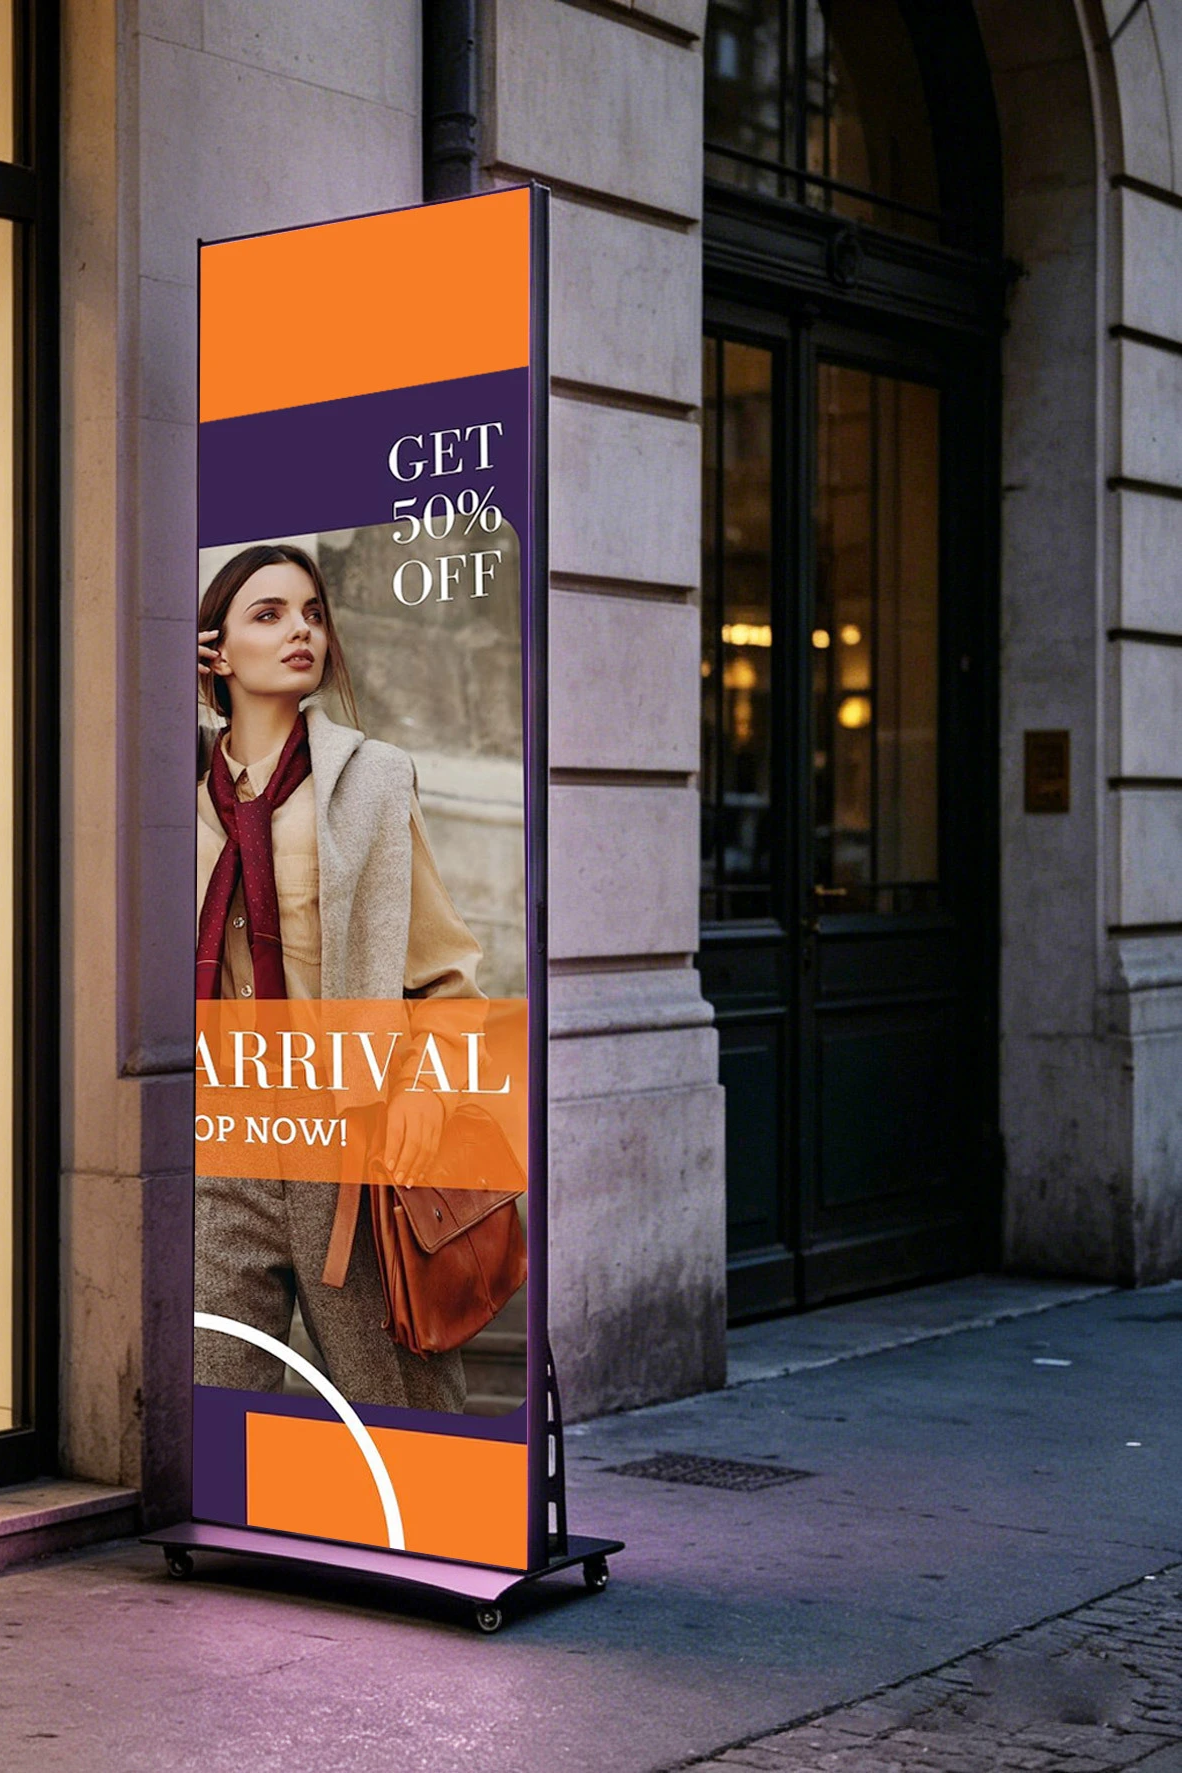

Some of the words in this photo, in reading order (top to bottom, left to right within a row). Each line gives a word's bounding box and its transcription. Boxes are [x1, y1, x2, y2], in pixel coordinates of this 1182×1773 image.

[388, 422, 503, 481] GET
[392, 486, 502, 544] 50%
[392, 550, 502, 606] OFF
[196, 1031, 510, 1093] ARRIVAL
[244, 1116, 347, 1146] NOW!
